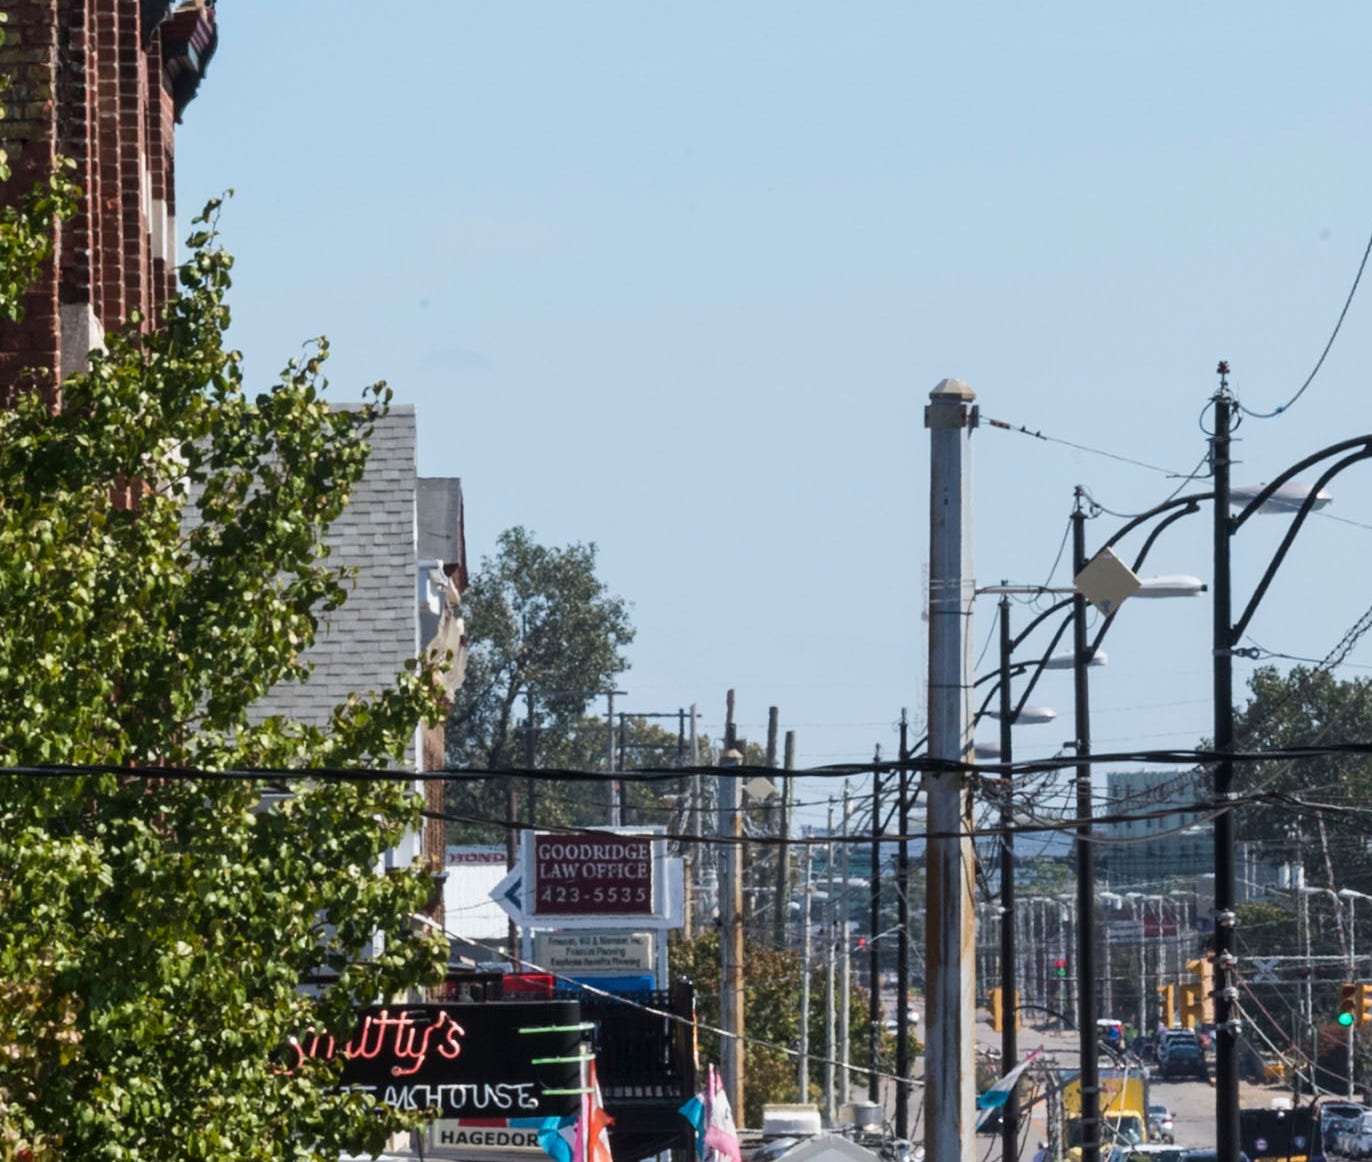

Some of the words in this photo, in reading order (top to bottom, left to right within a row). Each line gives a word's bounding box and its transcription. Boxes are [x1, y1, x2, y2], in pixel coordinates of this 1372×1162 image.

[449, 852, 506, 864] HOND
[538, 843, 648, 861] GOODRIDGE
[539, 862, 580, 879] LAW
[583, 862, 648, 879] OFFICE
[541, 886, 647, 903] 423-5535
[322, 1082, 539, 1110] AKHOUSE
[440, 1130, 541, 1147] HAGEDOR
